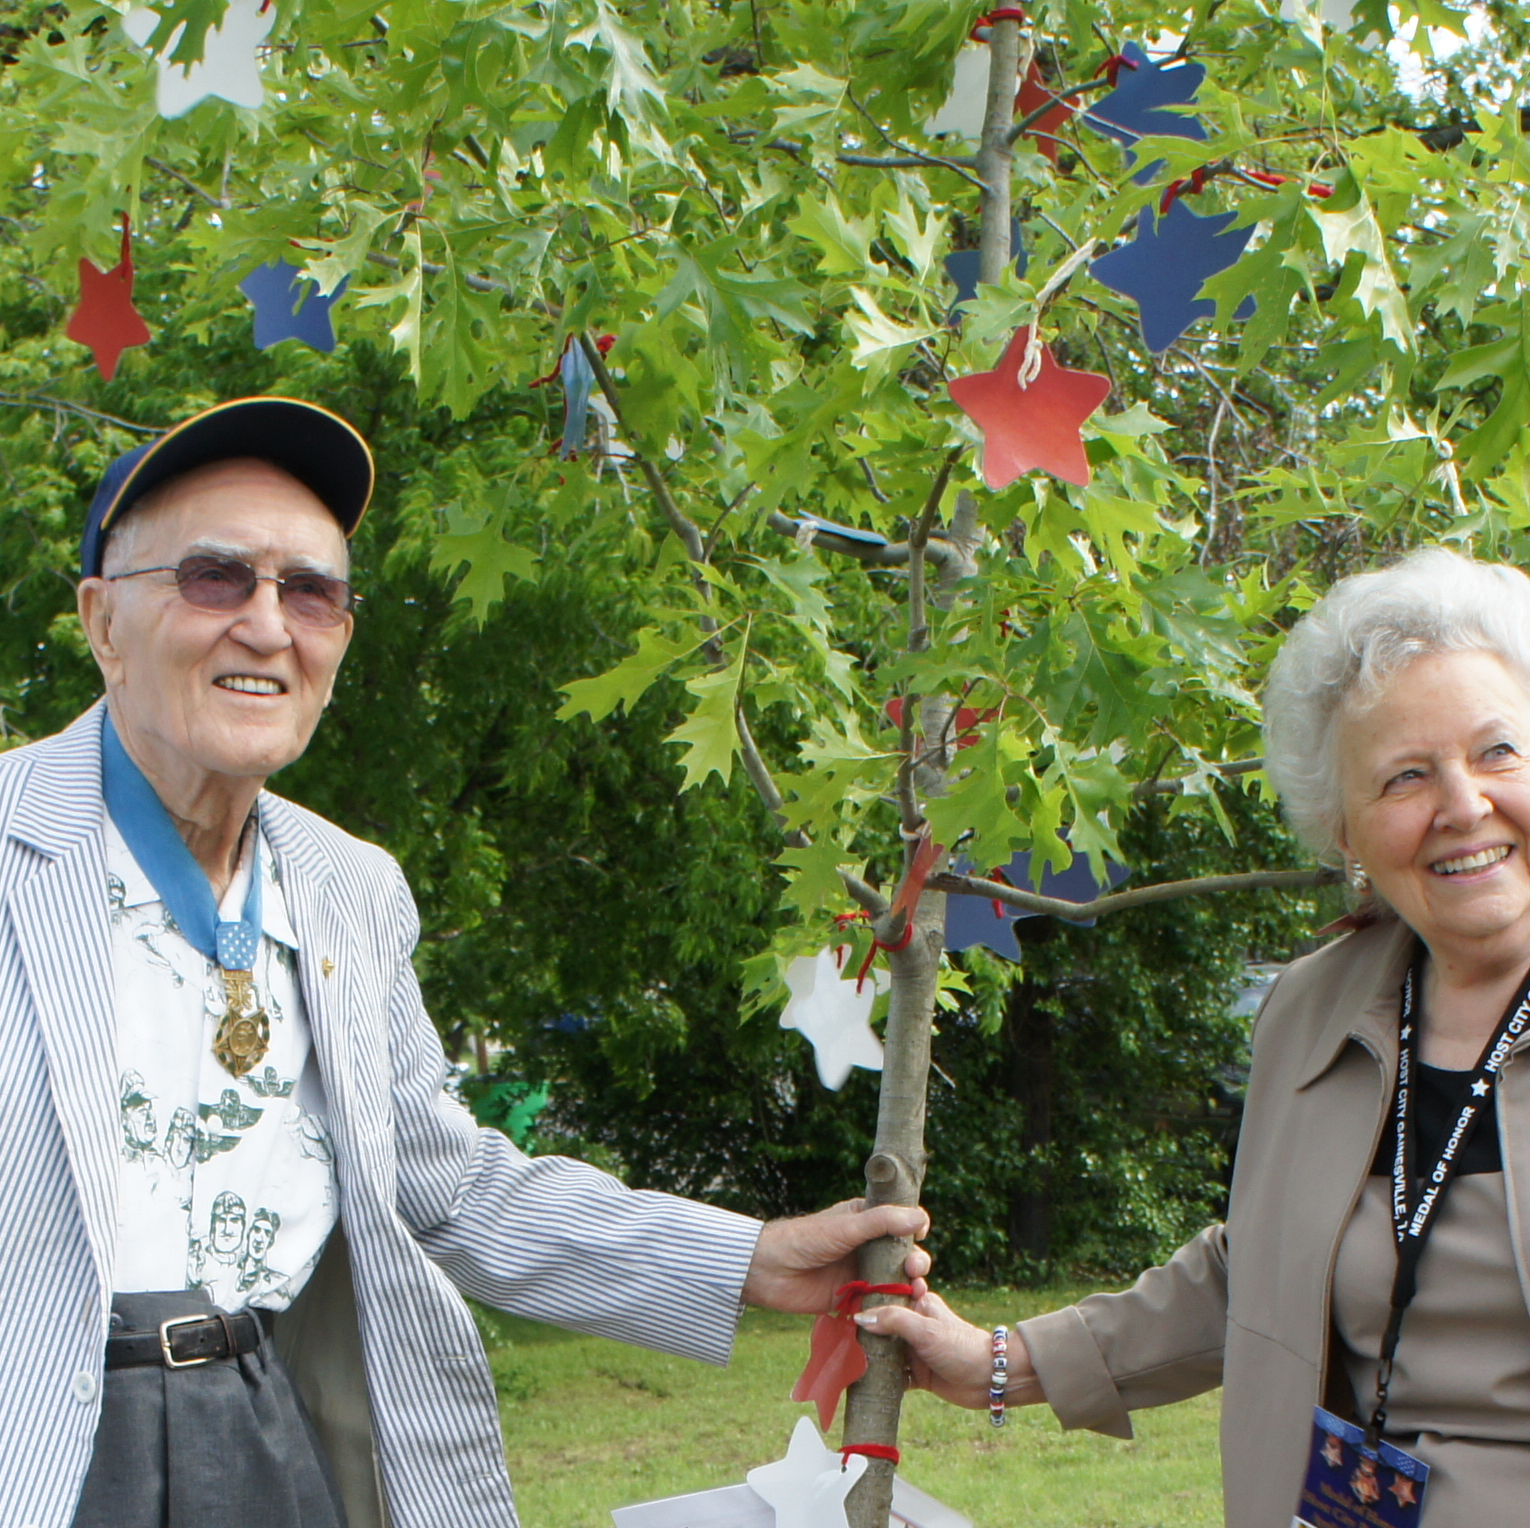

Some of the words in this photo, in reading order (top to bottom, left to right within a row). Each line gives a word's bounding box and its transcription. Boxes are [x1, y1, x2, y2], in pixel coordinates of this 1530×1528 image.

[1399, 1048, 1409, 1086] HOST
[1484, 1032, 1515, 1073] HOST
[1396, 1088, 1408, 1118] CITY
[1408, 1186, 1440, 1237] MEDAL
[1432, 1160, 1448, 1184] OF
[1442, 1105, 1476, 1161] HONOR
